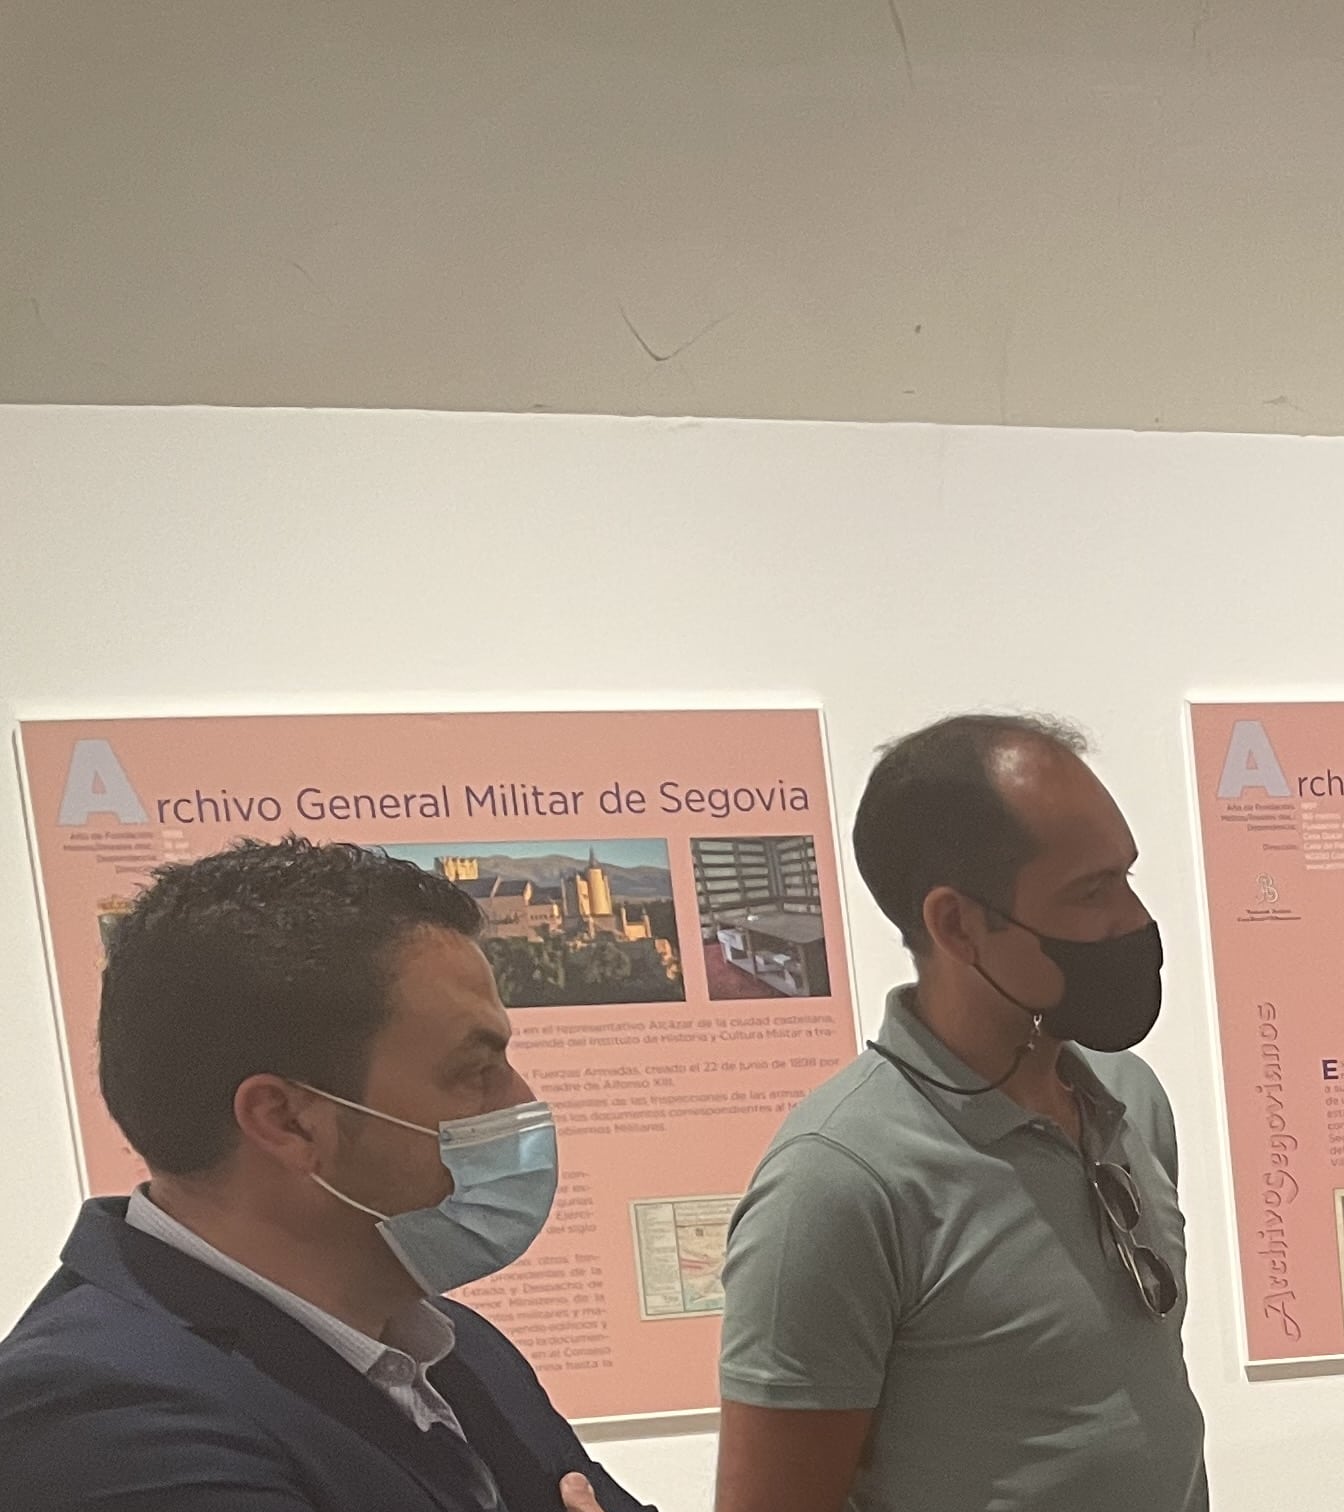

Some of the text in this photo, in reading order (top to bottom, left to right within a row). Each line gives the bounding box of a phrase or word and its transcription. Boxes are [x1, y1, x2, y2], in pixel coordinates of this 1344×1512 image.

[296, 785, 450, 821] General
[466, 781, 583, 817] Militar
[599, 780, 646, 816] de
[660, 778, 810, 821] Segovia
